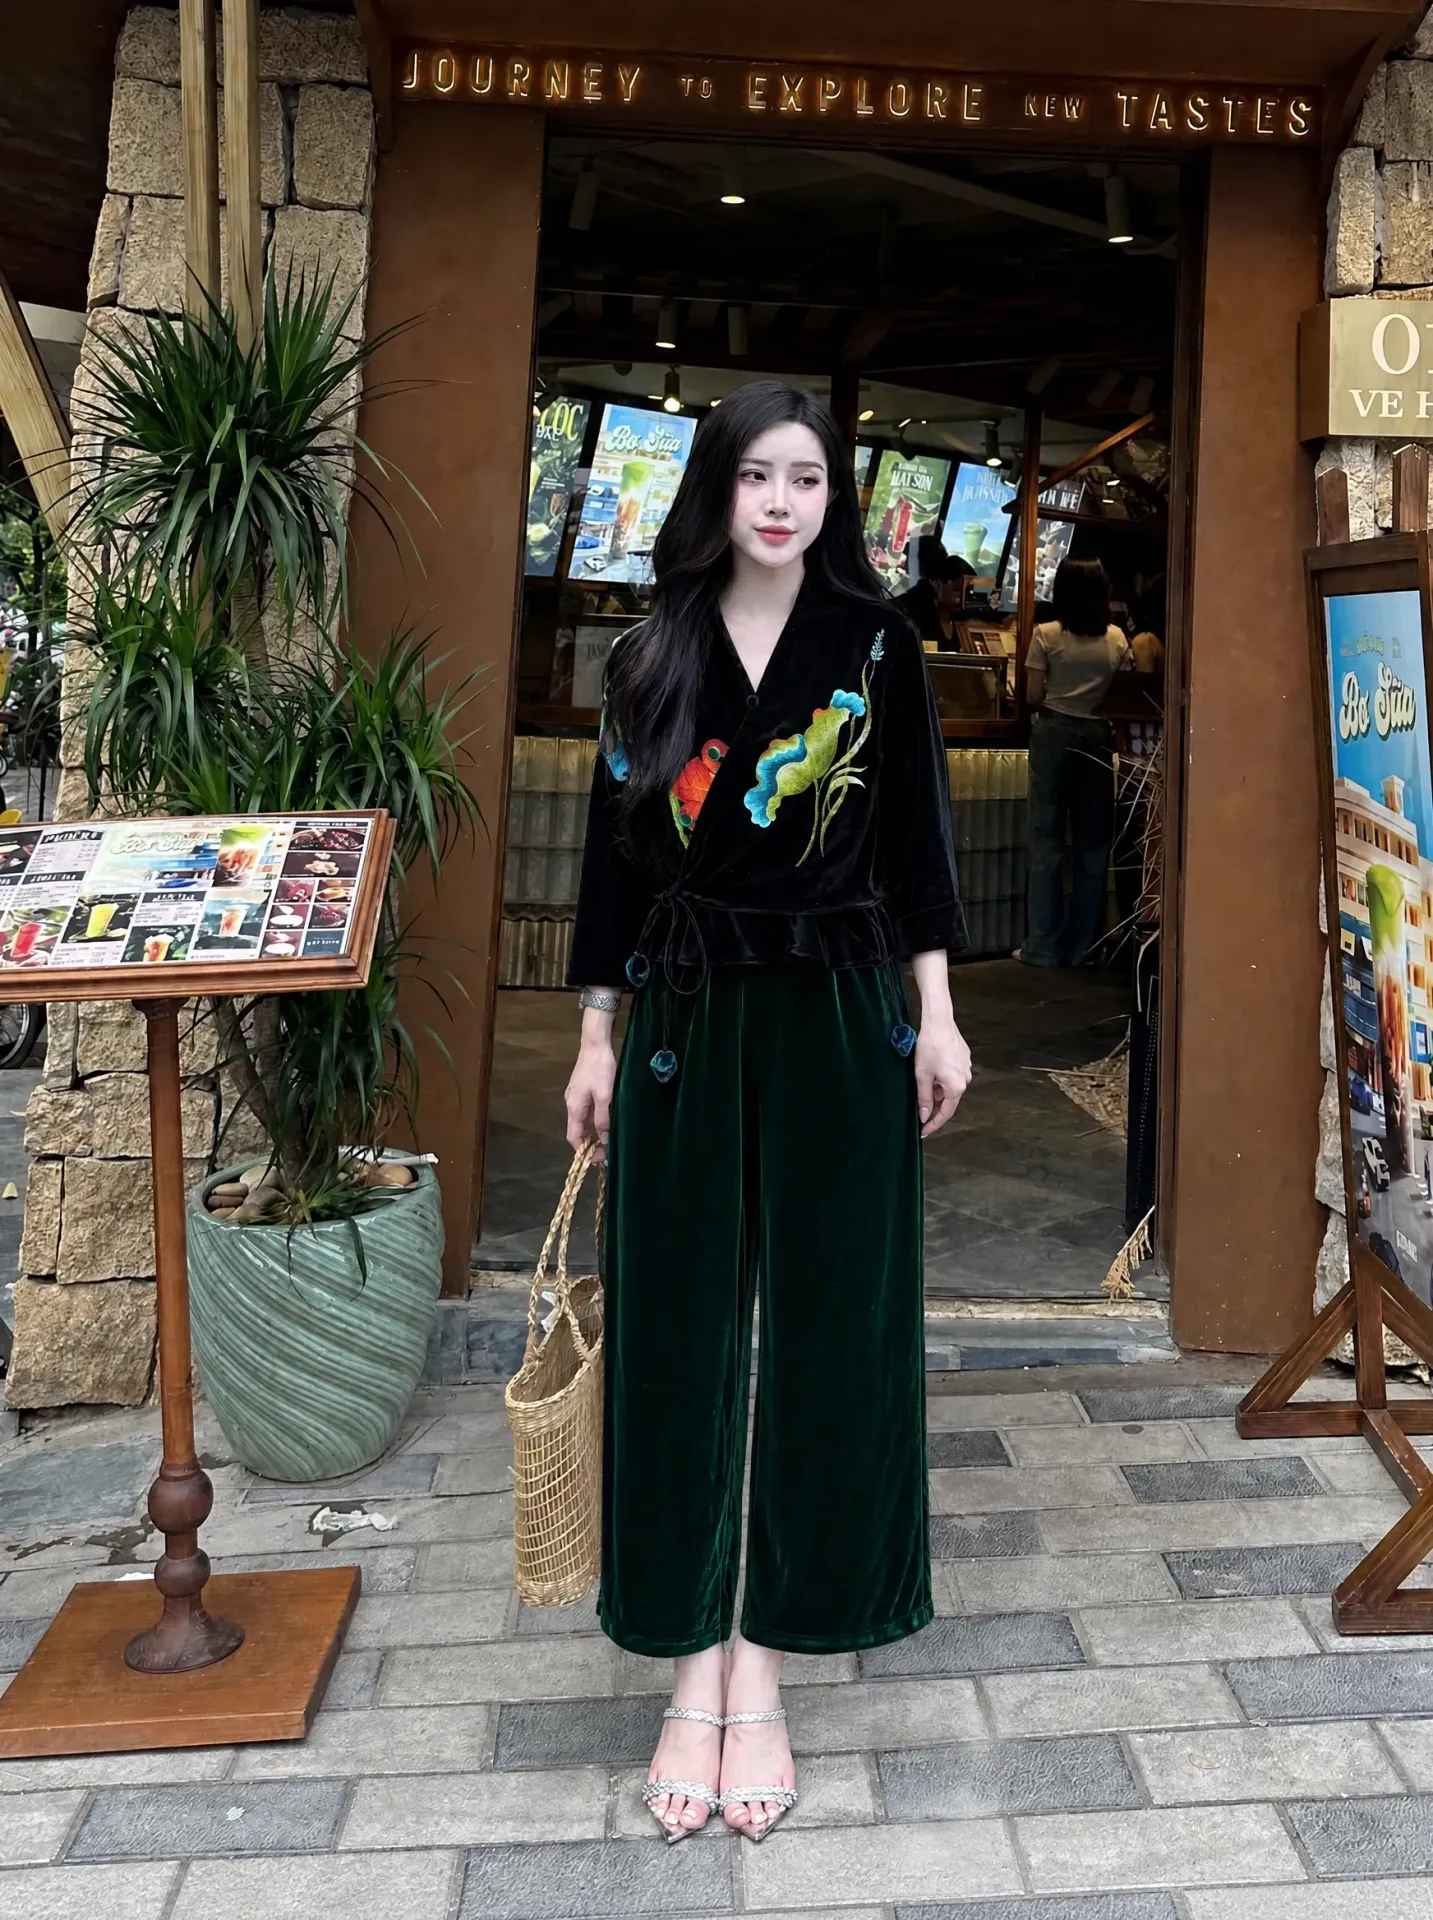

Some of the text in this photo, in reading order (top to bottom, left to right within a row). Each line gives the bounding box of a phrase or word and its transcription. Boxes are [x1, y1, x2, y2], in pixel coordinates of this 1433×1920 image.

[401, 52, 1314, 137] JOURNEY TO EXPLORE NEW TASTES
[1348, 388, 1404, 419] VE
